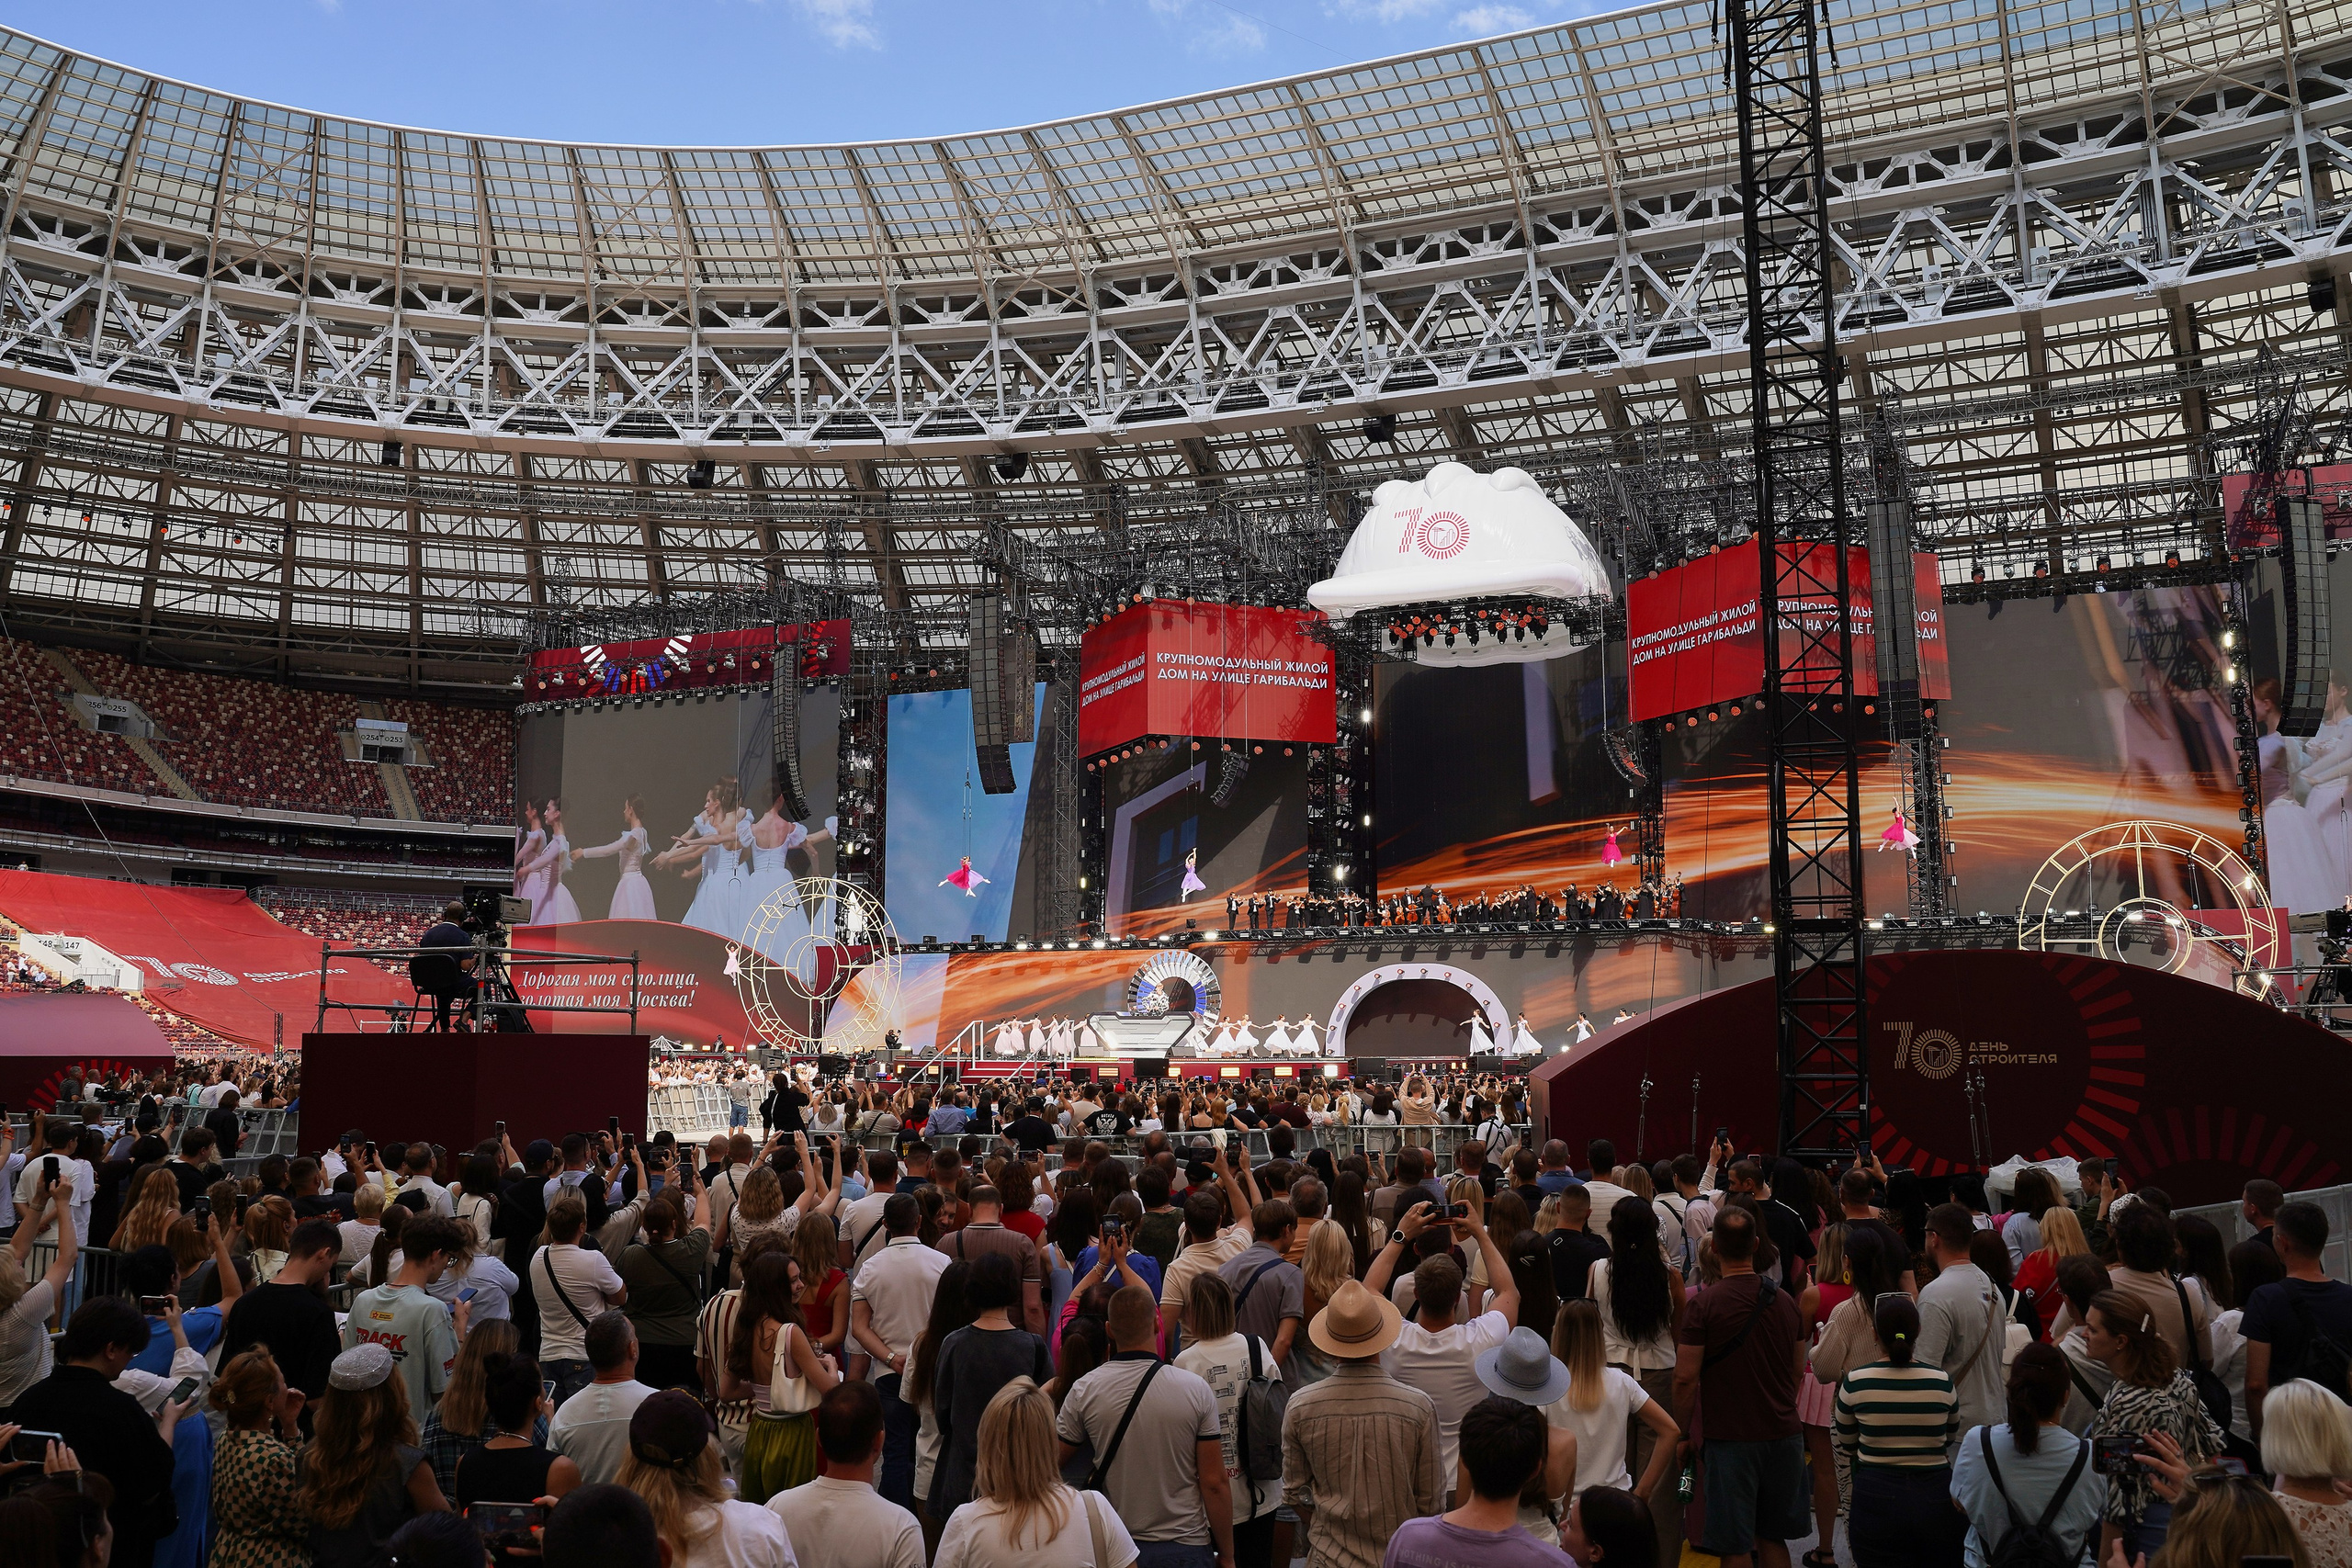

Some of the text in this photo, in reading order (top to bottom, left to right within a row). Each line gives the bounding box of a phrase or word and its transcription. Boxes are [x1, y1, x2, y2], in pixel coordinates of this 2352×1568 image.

[1632, 599, 1756, 649] КРУПНОМОДУЛЬНЫЙ ЖИЛОЙ
[1806, 619, 1823, 630] НА
[1826, 620, 1863, 635] УЛЦЕ
[1633, 619, 1756, 665] ДОМ НА УЛИЦЕ ГАРИБАЛЬДИ
[1082, 651, 1146, 693] КРУПНОМОДУЛЬНЫЙ ЖИЛОЙ
[1157, 652, 1329, 674] КРУПНОМОДУЛЬНЫЙ ЖИЛОЙ
[1158, 668, 1328, 689] ДОМ НА УЛИЦЕ ГАРИБАЛЬДИ
[1082, 670, 1145, 707] ДОМ НА УЛИЦЕ ГАРИБАЛЬДИ
[112, 705, 127, 713] 255
[39, 940, 53, 948] 48
[517, 971, 581, 989] Дорогая
[584, 974, 616, 987] моя
[588, 994, 621, 1008] моя
[1968, 1042, 2009, 1052] ДЕНЬ
[1969, 1055, 2058, 1064] СТРОИТЕЛЯ
